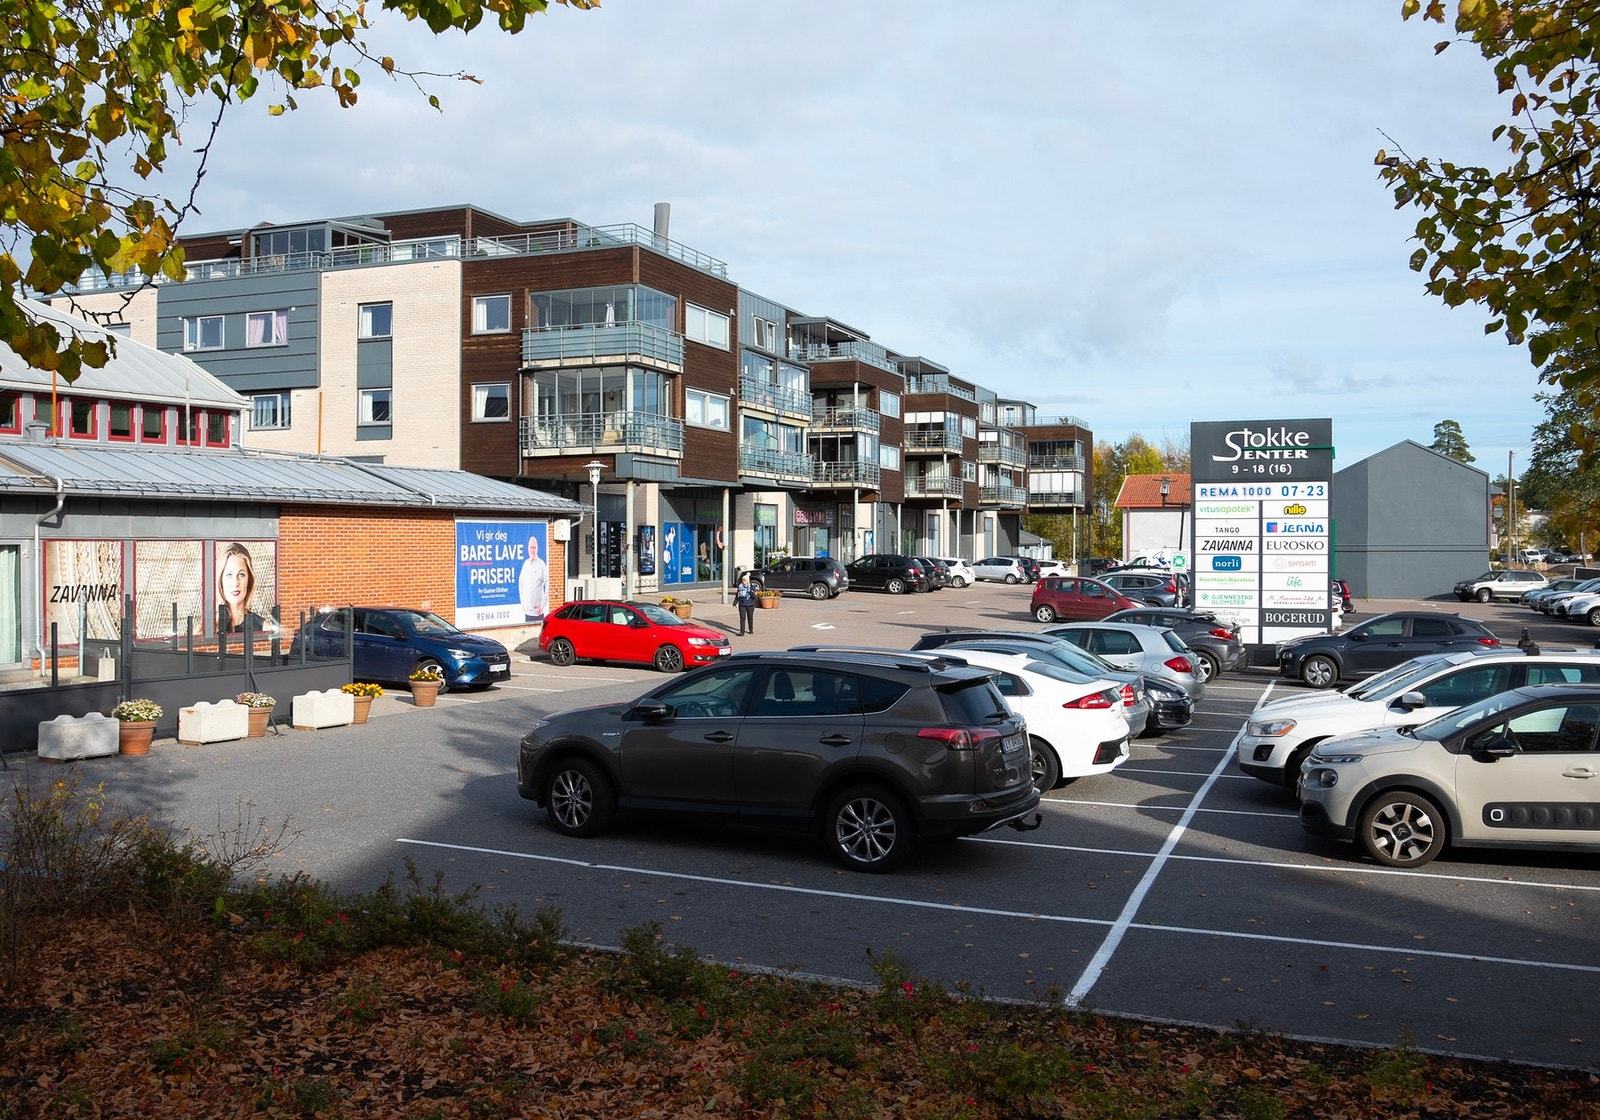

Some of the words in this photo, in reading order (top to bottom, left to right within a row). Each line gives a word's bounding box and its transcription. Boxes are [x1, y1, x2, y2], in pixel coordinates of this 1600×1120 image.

[1212, 427, 1310, 462] Stokke
[1232, 465, 1239, 474] 9
[1253, 464, 1265, 473] 18
[1269, 464, 1292, 475] (16)
[1200, 488, 1238, 497] REMA
[1243, 487, 1271, 496] 1000
[1281, 486, 1324, 497] 07-23
[476, 530, 484, 540] Vi
[486, 530, 494, 542] gir
[495, 530, 508, 542] deg
[1201, 540, 1253, 551] ZAVANNA
[1266, 541, 1324, 551] EUROSKO
[461, 544, 492, 562] BARE
[495, 544, 524, 561] LAVE
[1215, 559, 1239, 567] norli
[470, 567, 515, 585] PRISER!
[1265, 612, 1325, 623] BOGERUD
